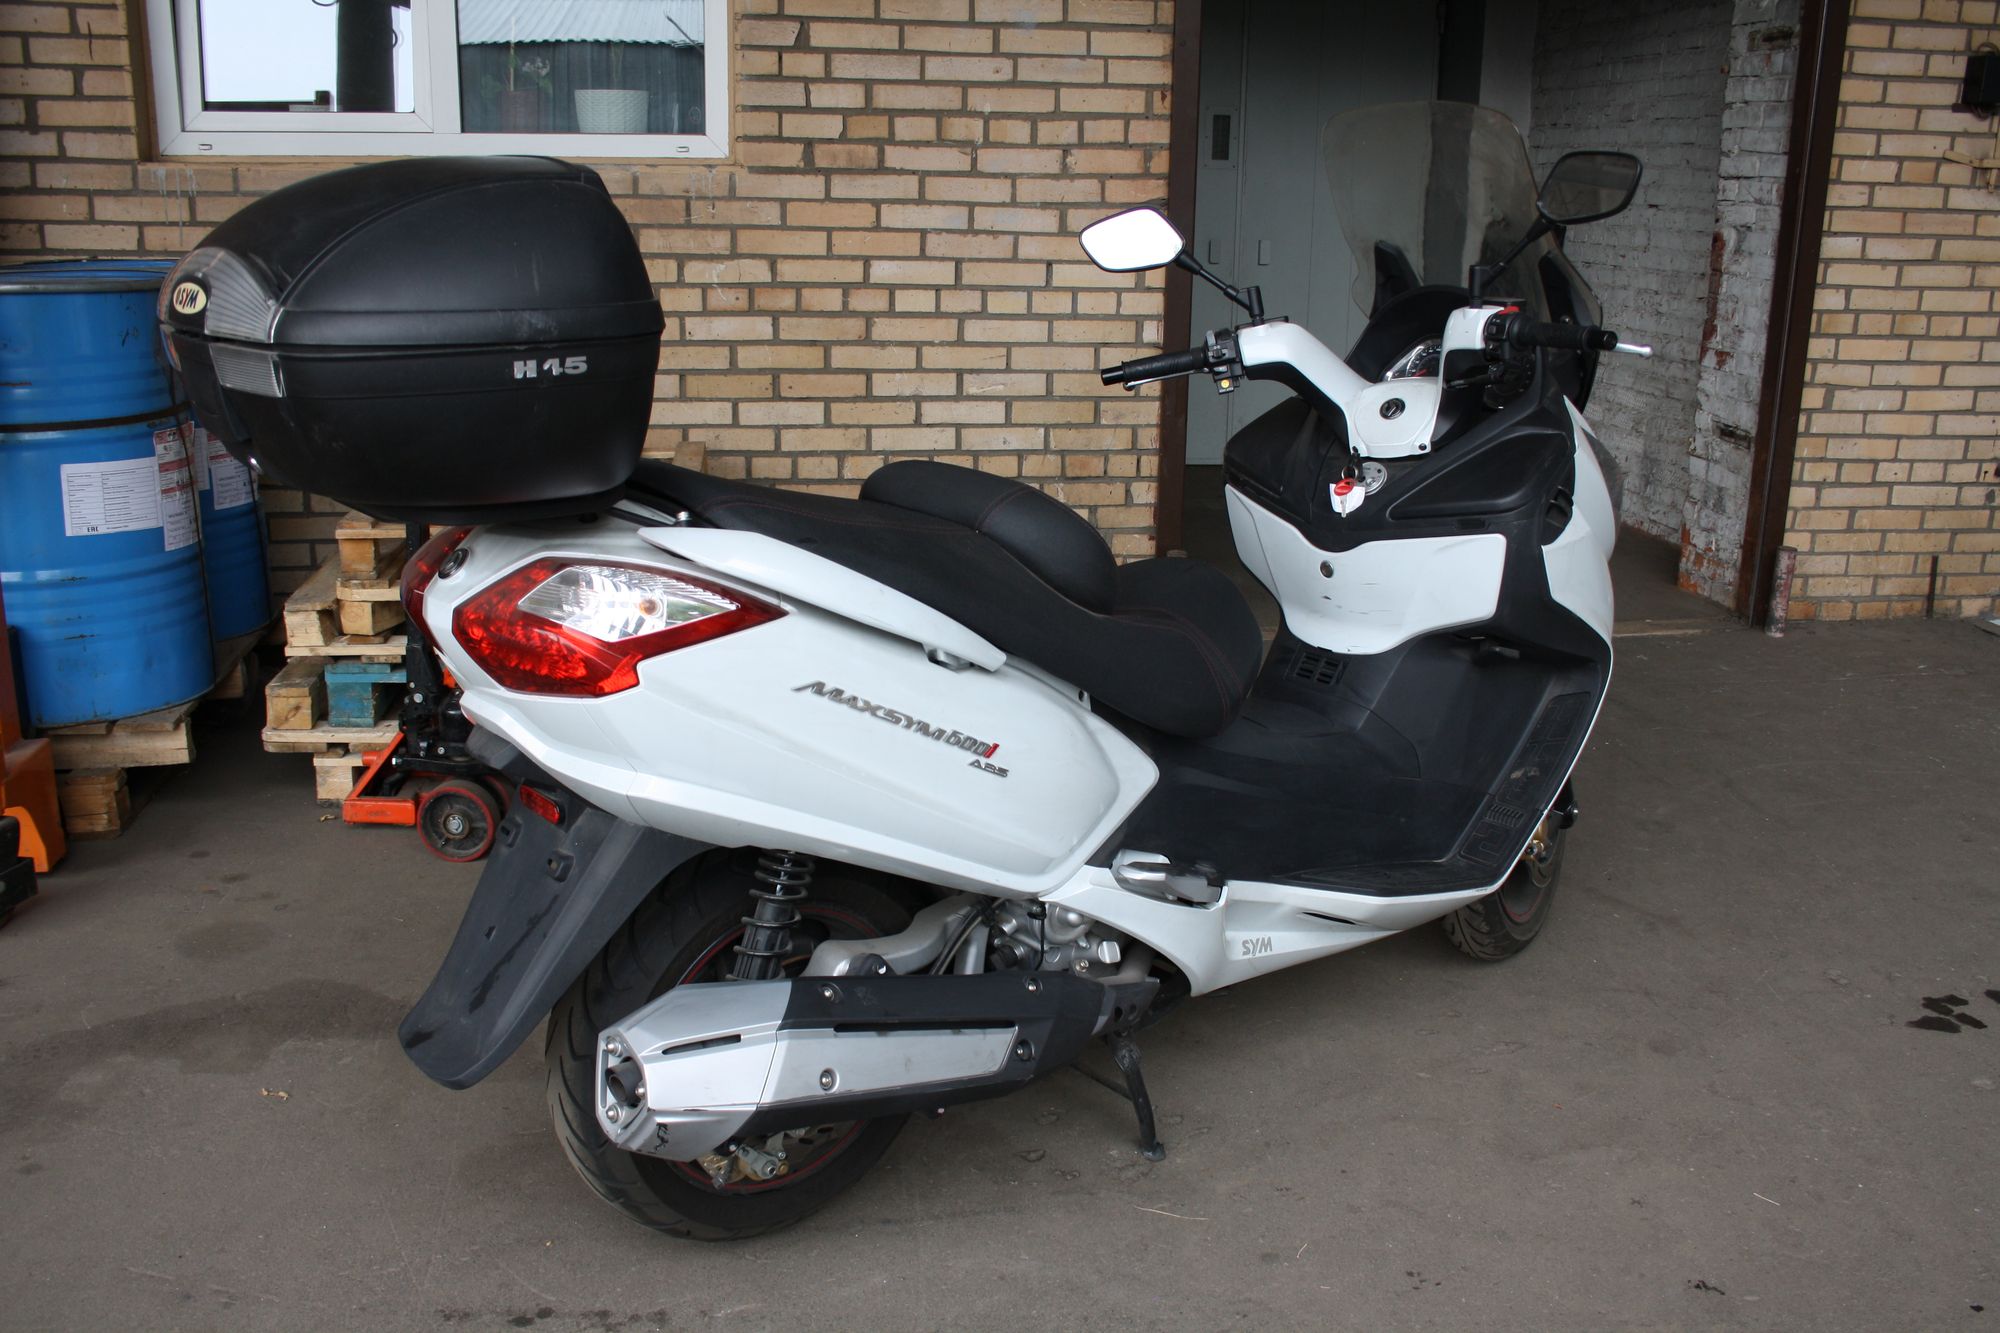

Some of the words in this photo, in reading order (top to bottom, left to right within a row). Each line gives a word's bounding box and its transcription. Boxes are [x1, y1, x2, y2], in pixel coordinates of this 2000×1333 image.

[178, 287, 200, 310] SYM
[968, 758, 1010, 778] ABS
[1241, 936, 1273, 956] SYM
